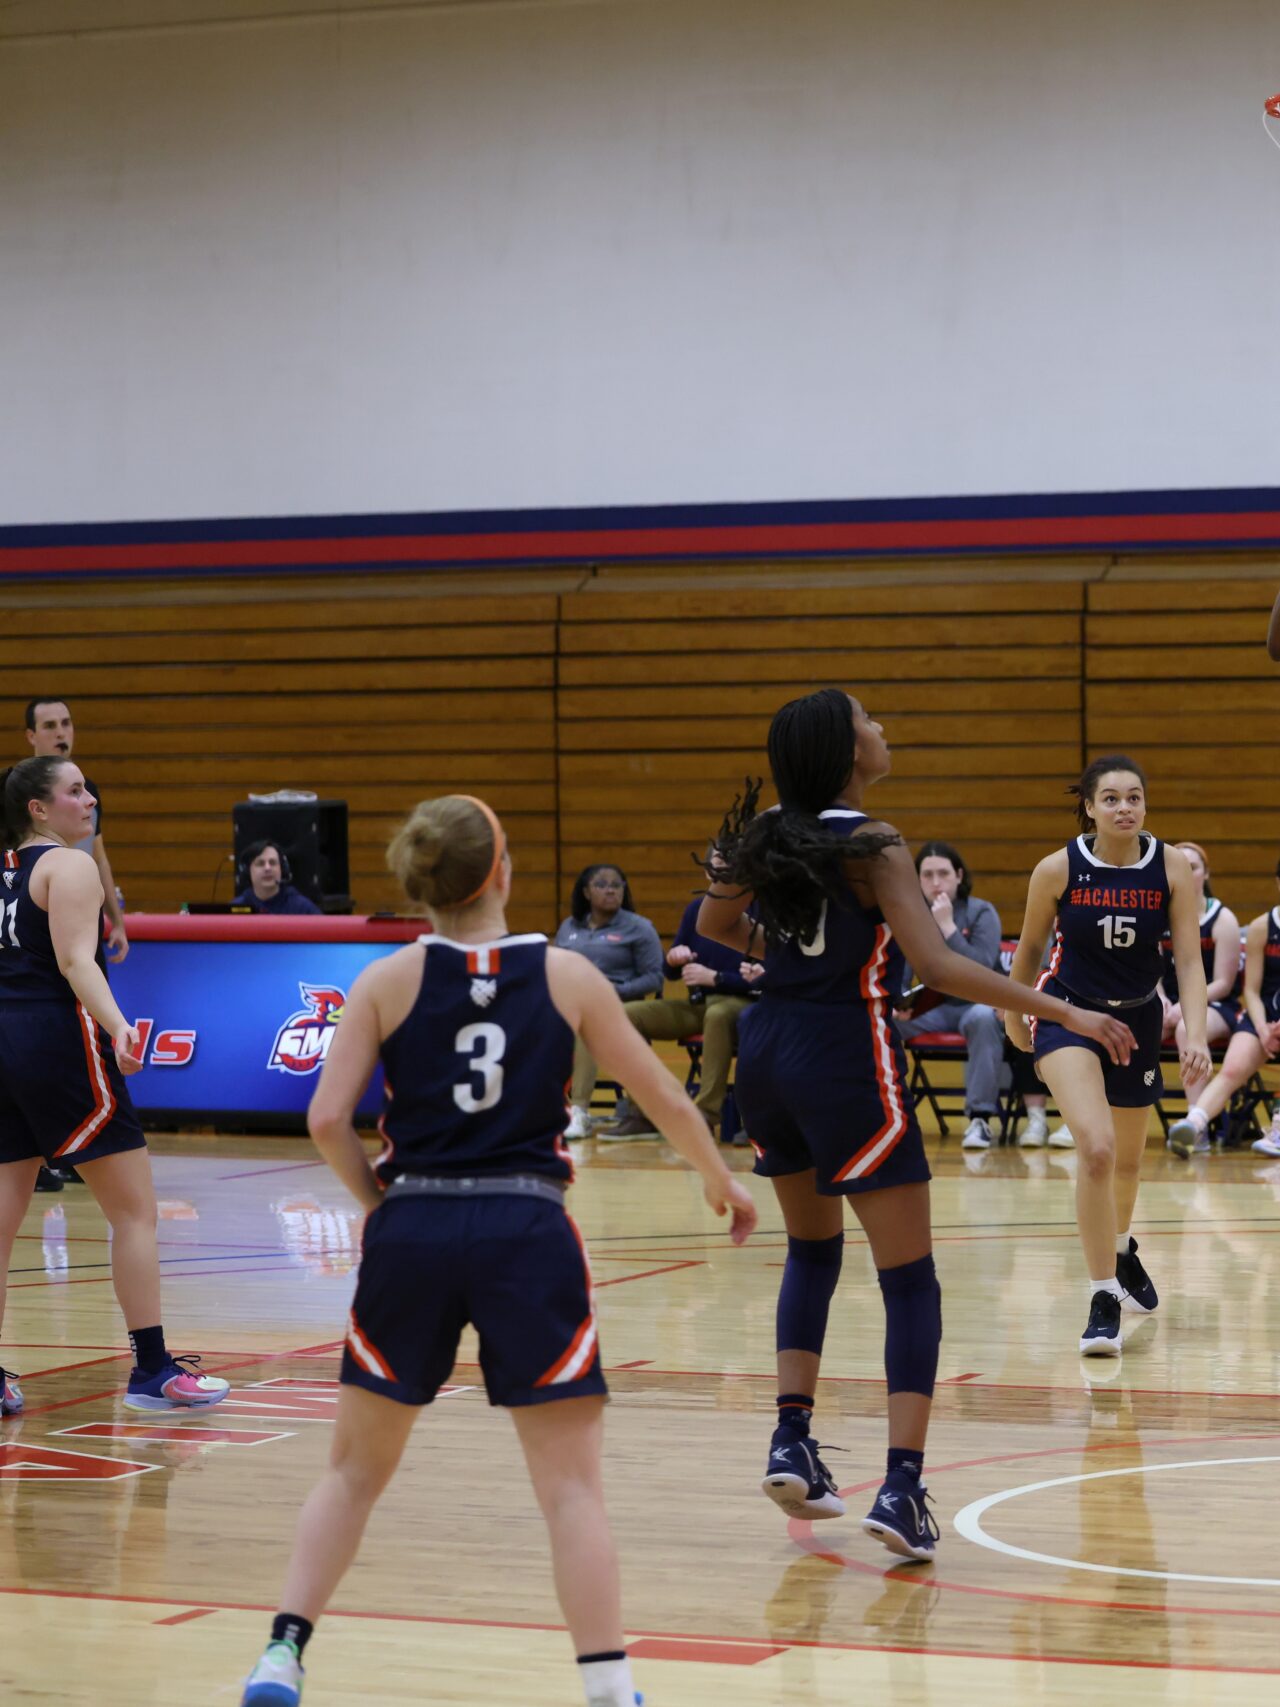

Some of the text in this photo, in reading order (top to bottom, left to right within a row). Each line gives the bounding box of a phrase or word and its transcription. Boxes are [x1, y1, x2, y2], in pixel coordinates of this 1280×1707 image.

[1070, 887, 1163, 911] MACALESTER
[1096, 914, 1137, 950] 15
[276, 1025, 337, 1060] SM
[453, 1021, 507, 1114] 3
